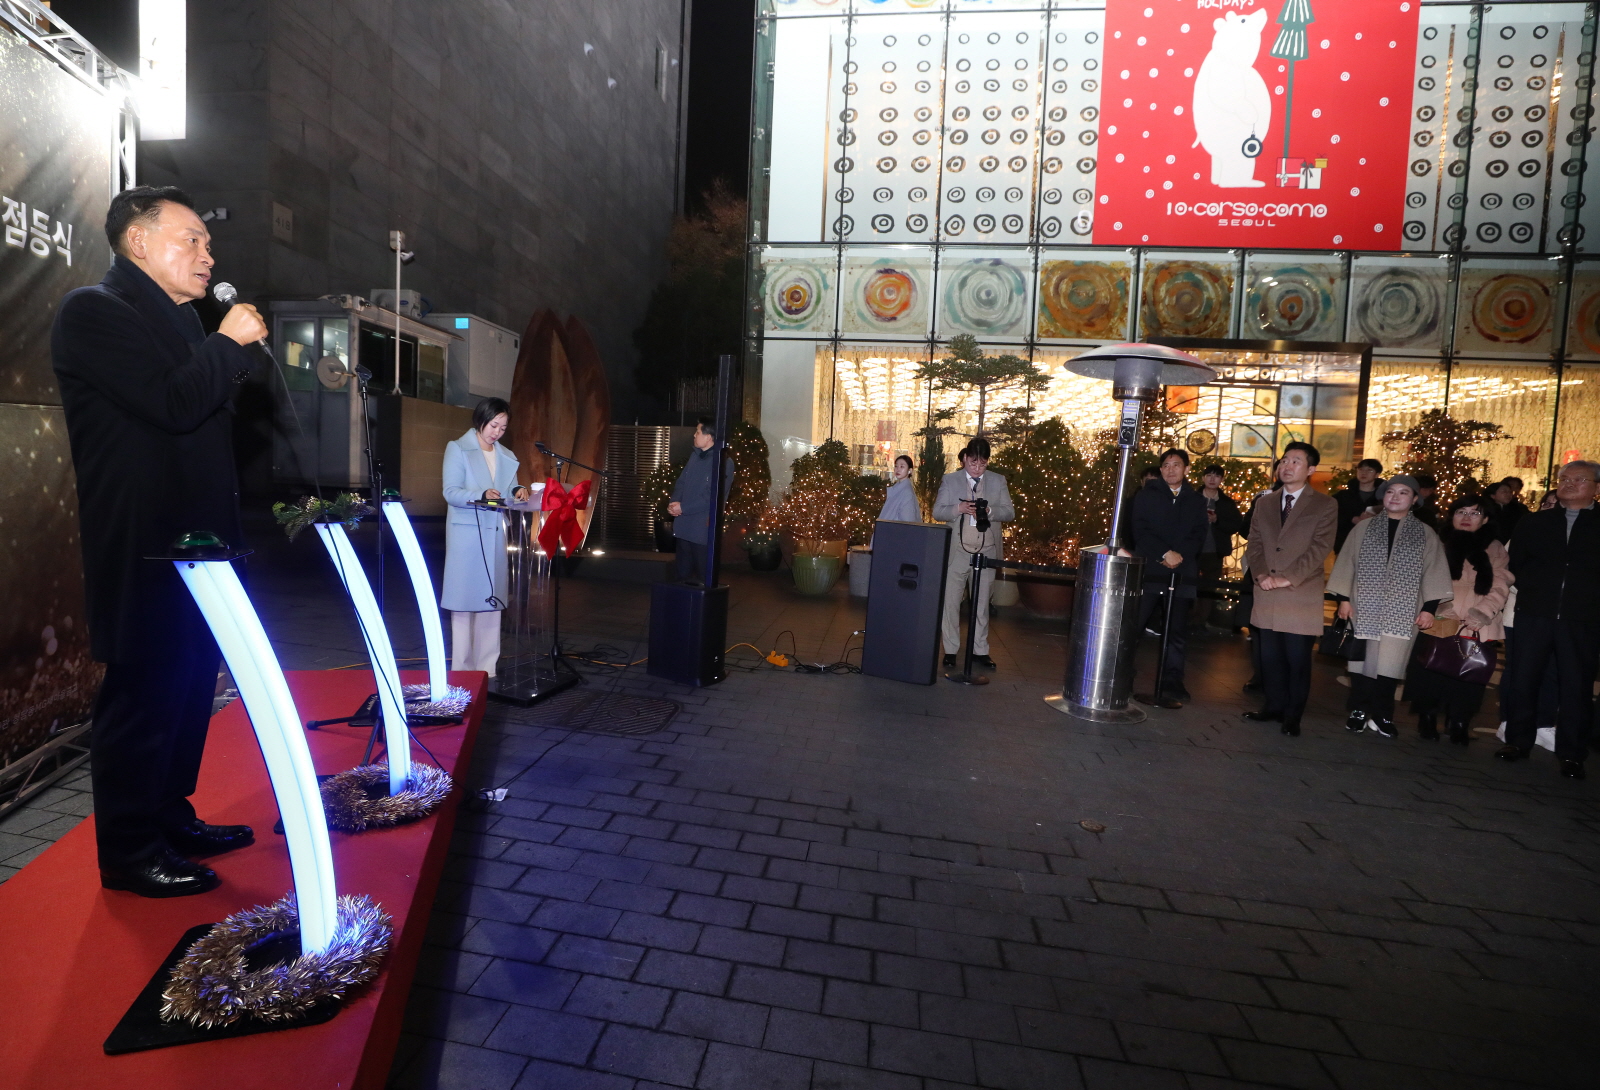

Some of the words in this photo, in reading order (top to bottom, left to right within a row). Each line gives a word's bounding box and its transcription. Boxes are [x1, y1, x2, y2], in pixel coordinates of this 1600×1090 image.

[275, 216, 291, 231] 418
[1218, 218, 1276, 227] SEOUL
[1, 195, 73, 267] 점등식
